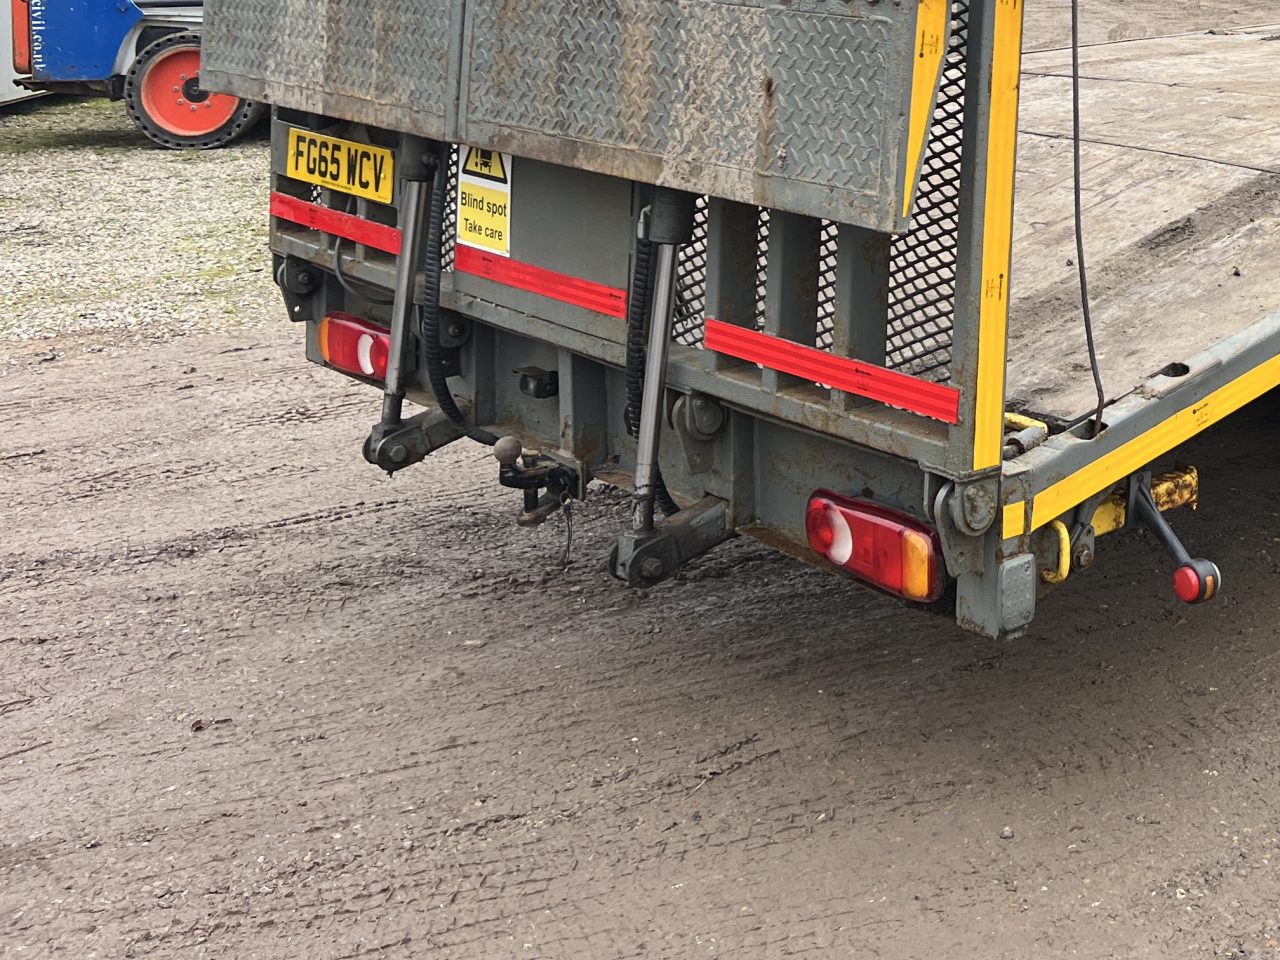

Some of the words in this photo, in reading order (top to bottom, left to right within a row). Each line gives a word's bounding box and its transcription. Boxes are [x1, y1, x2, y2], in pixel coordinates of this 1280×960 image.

[294, 134, 342, 182] FG65
[346, 146, 385, 193] WCV
[460, 191, 484, 211] Blind
[486, 201, 507, 218] spot
[464, 217, 483, 236] Take
[484, 226, 503, 241] care
